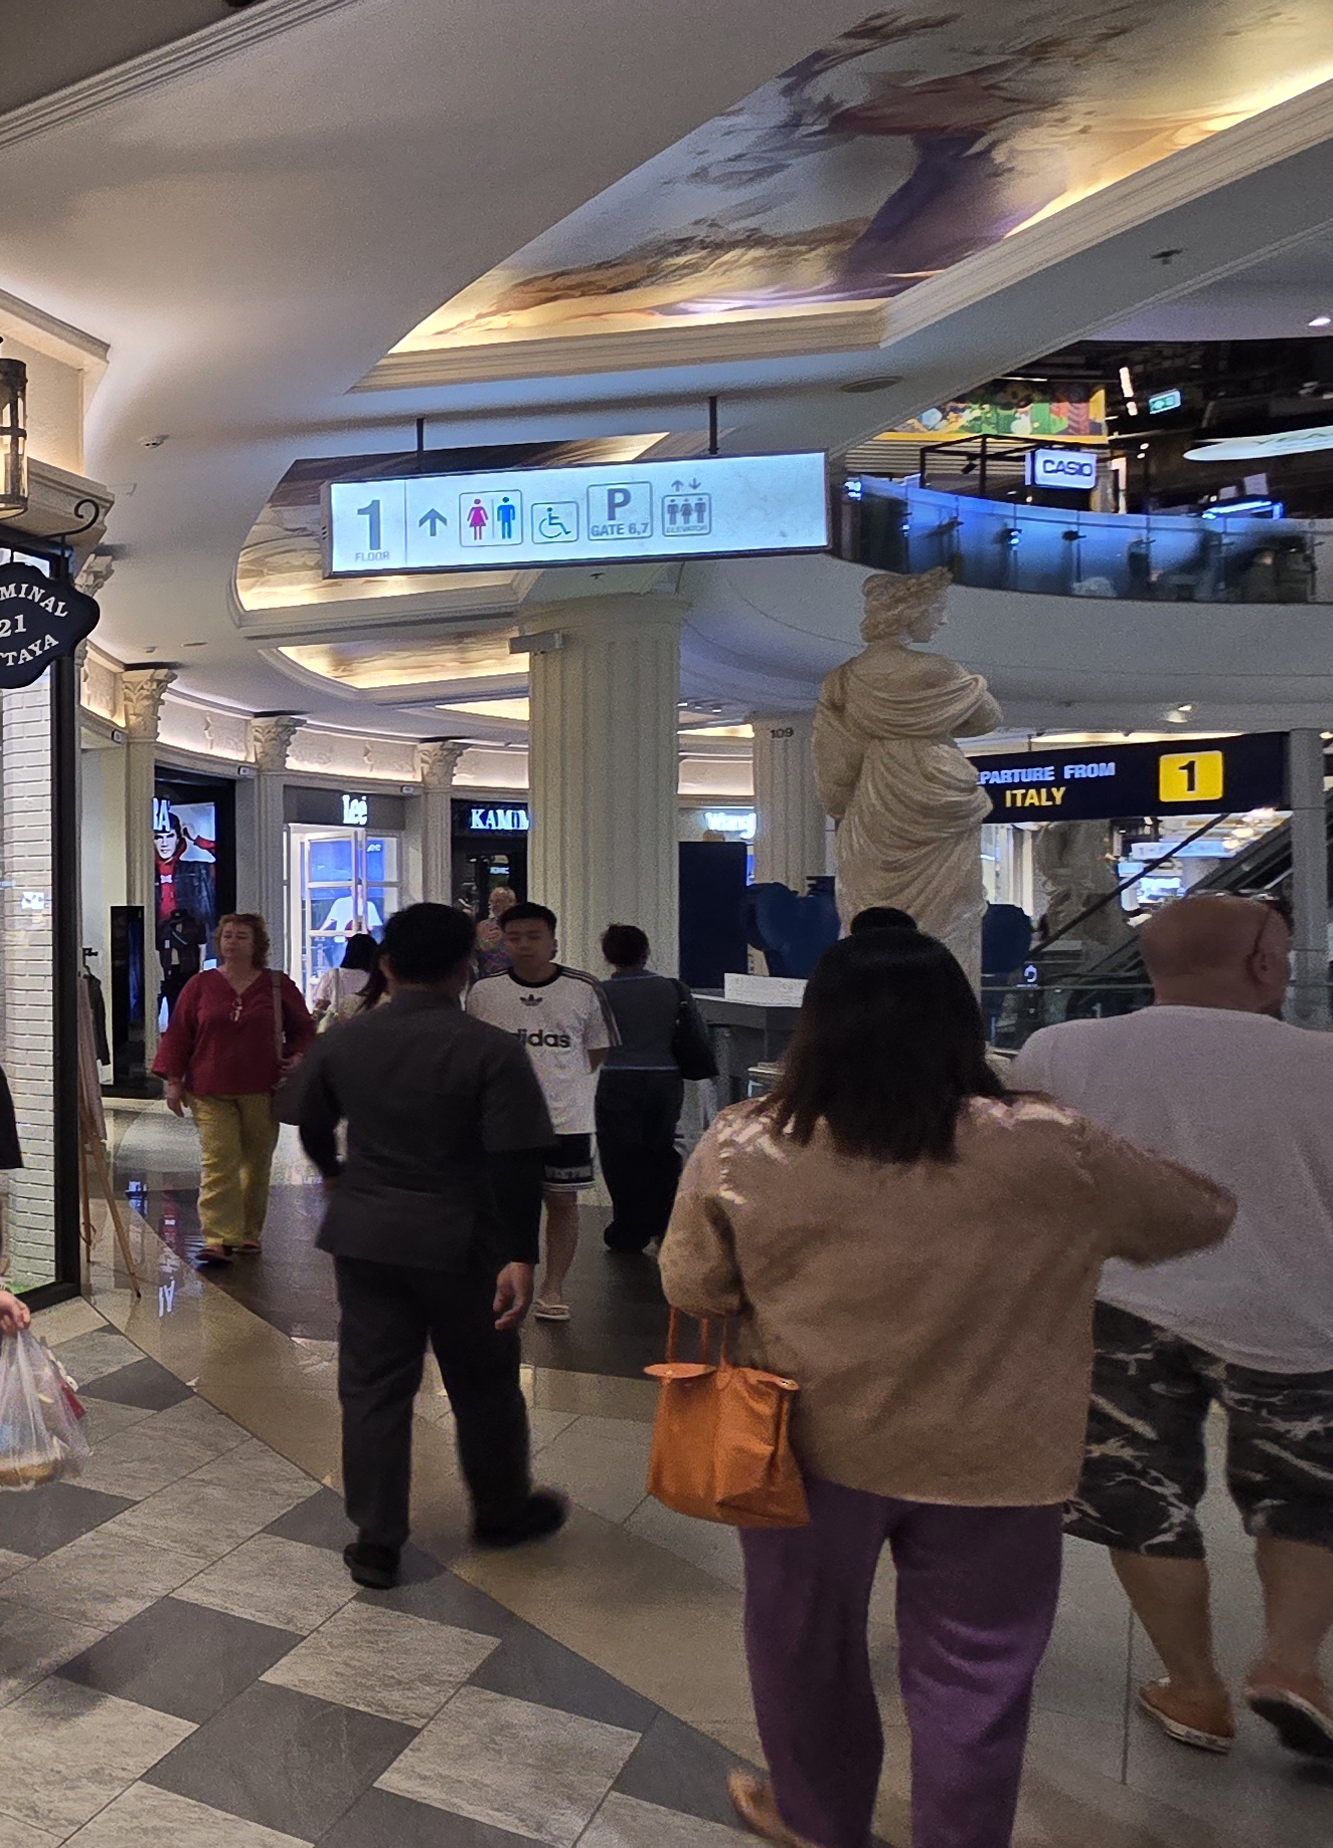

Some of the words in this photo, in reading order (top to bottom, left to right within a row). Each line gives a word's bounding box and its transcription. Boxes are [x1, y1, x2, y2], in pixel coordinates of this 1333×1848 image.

[1042, 459, 1093, 477] CASIO
[607, 487, 632, 521] P
[357, 499, 381, 551] 1
[590, 523, 625, 537] GATE
[628, 522, 649, 536] 6,7
[354, 550, 390, 563] FLOOR
[770, 727, 794, 739] 109
[976, 766, 1055, 785] PARTURE
[1064, 762, 1116, 779] FROM
[1179, 760, 1197, 793] 1
[1005, 786, 1067, 808] ITALY
[342, 795, 368, 826] Lee
